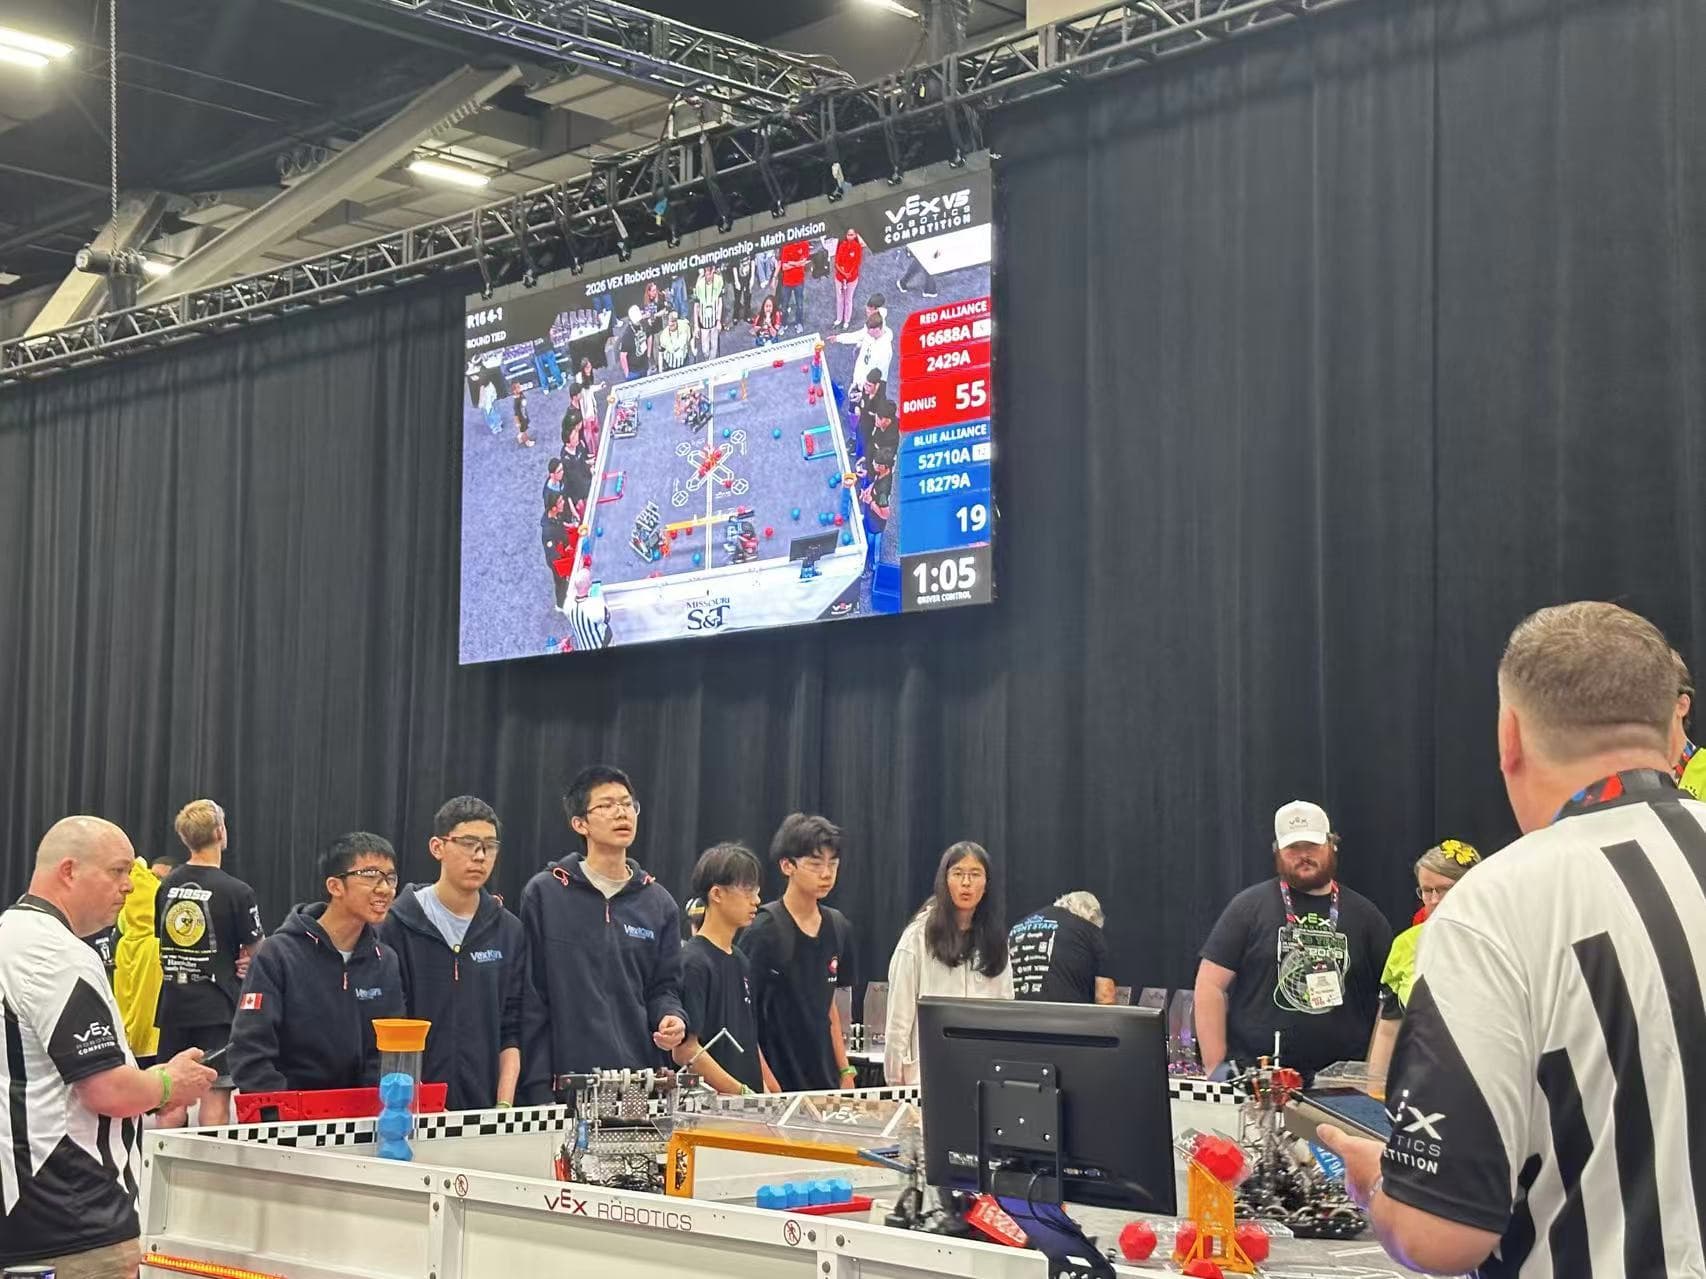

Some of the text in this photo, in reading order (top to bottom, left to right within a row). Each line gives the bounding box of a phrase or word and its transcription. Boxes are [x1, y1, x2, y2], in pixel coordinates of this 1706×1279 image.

[885, 189, 970, 224] VEX V5
[885, 205, 970, 233] ROBOTICS
[885, 213, 971, 244] COMPETITION
[585, 282, 606, 296] 2026
[607, 275, 623, 290] VEX
[624, 267, 660, 285] Robotics
[661, 258, 688, 275] World
[689, 241, 754, 267] Championship
[760, 231, 786, 248] Math
[787, 221, 825, 240] Division
[487, 306, 503, 323] 4-1
[920, 300, 988, 325] RED ALLIANCE
[919, 324, 971, 349] 16688A
[926, 349, 971, 372] 2429A
[903, 379, 987, 414] BONUS 55
[913, 423, 987, 447] BLUE ALLIANCE
[918, 447, 971, 470] 52710A
[918, 472, 971, 494] 18279A
[956, 503, 987, 532] 19
[913, 556, 976, 593] 1:05
[687, 605, 731, 630] S&T
[73, 1022, 113, 1042] VEX
[543, 1188, 693, 1231] VEX ROBOTICS
